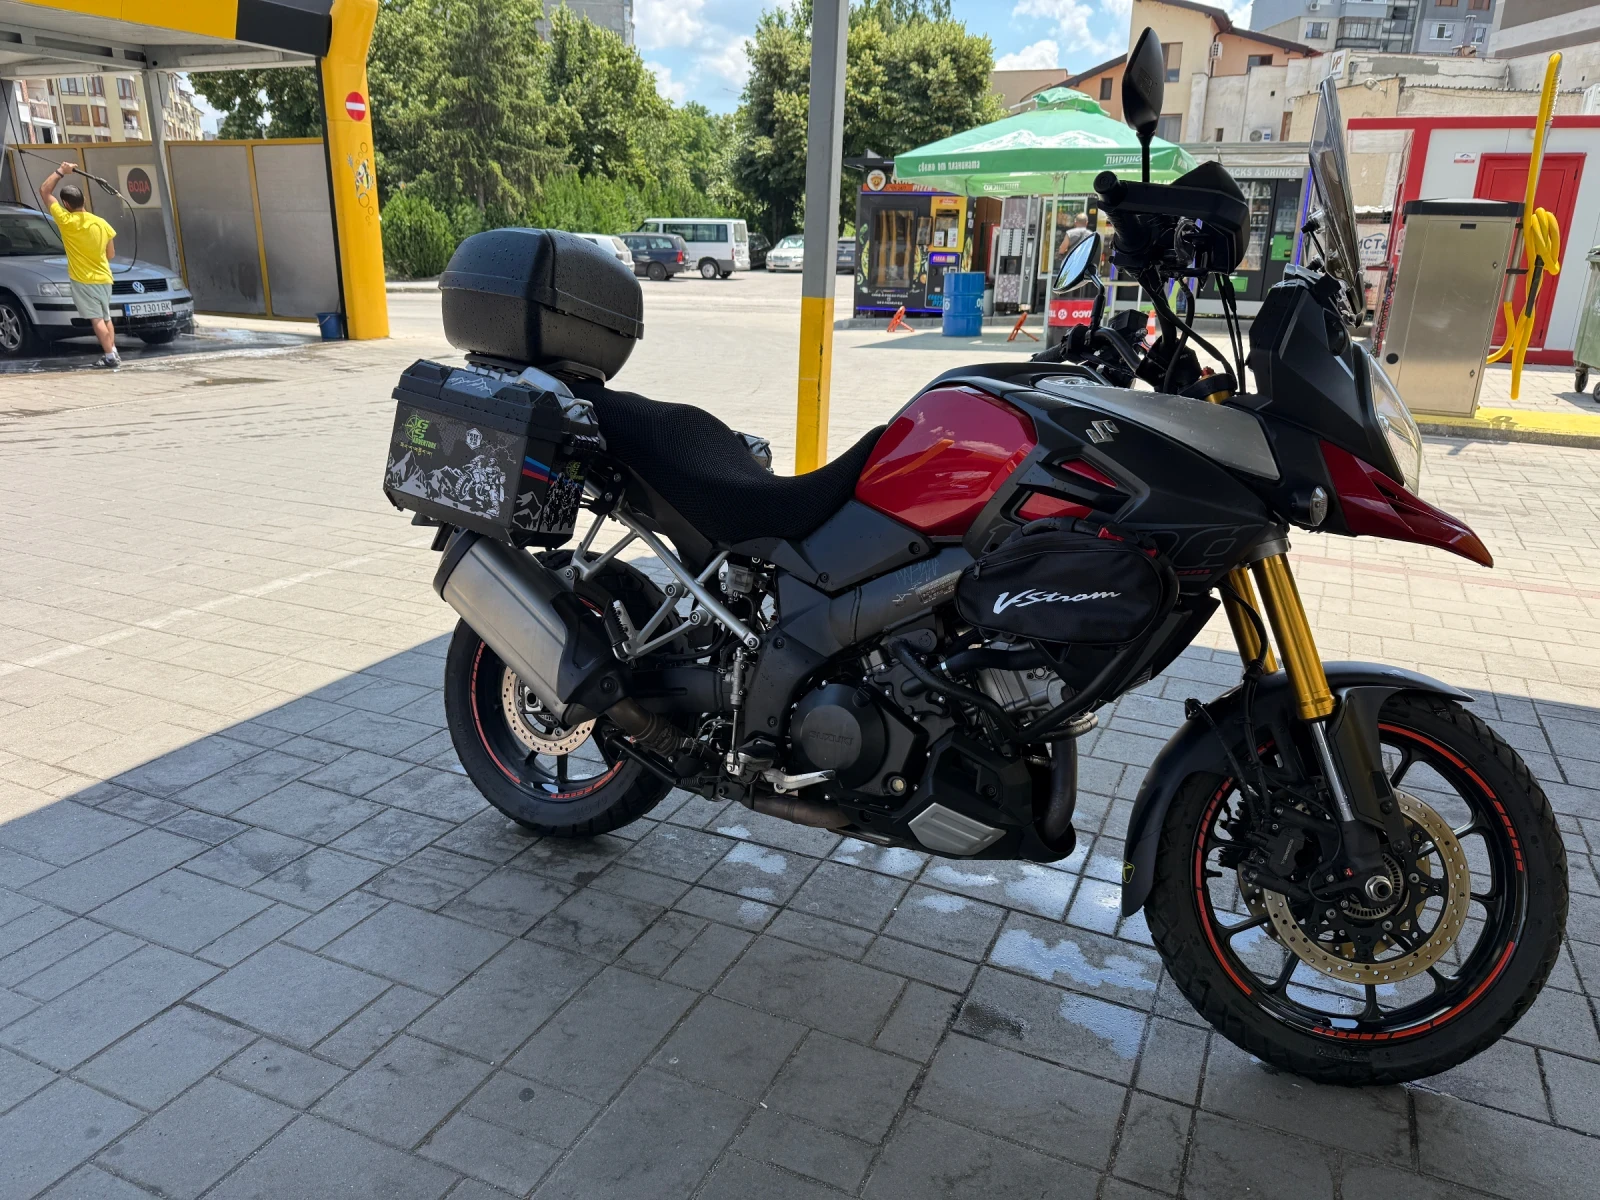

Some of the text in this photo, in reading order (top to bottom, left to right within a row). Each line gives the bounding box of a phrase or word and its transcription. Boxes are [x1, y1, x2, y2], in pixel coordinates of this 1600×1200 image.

[1106, 155, 1153, 165] ПИРИНС
[1229, 167, 1252, 176] ACKS
[1264, 167, 1298, 177] DRINKS
[128, 181, 150, 194] ВОДА
[1072, 310, 1093, 318] ACO
[808, 730, 854, 746] SUZUKI
